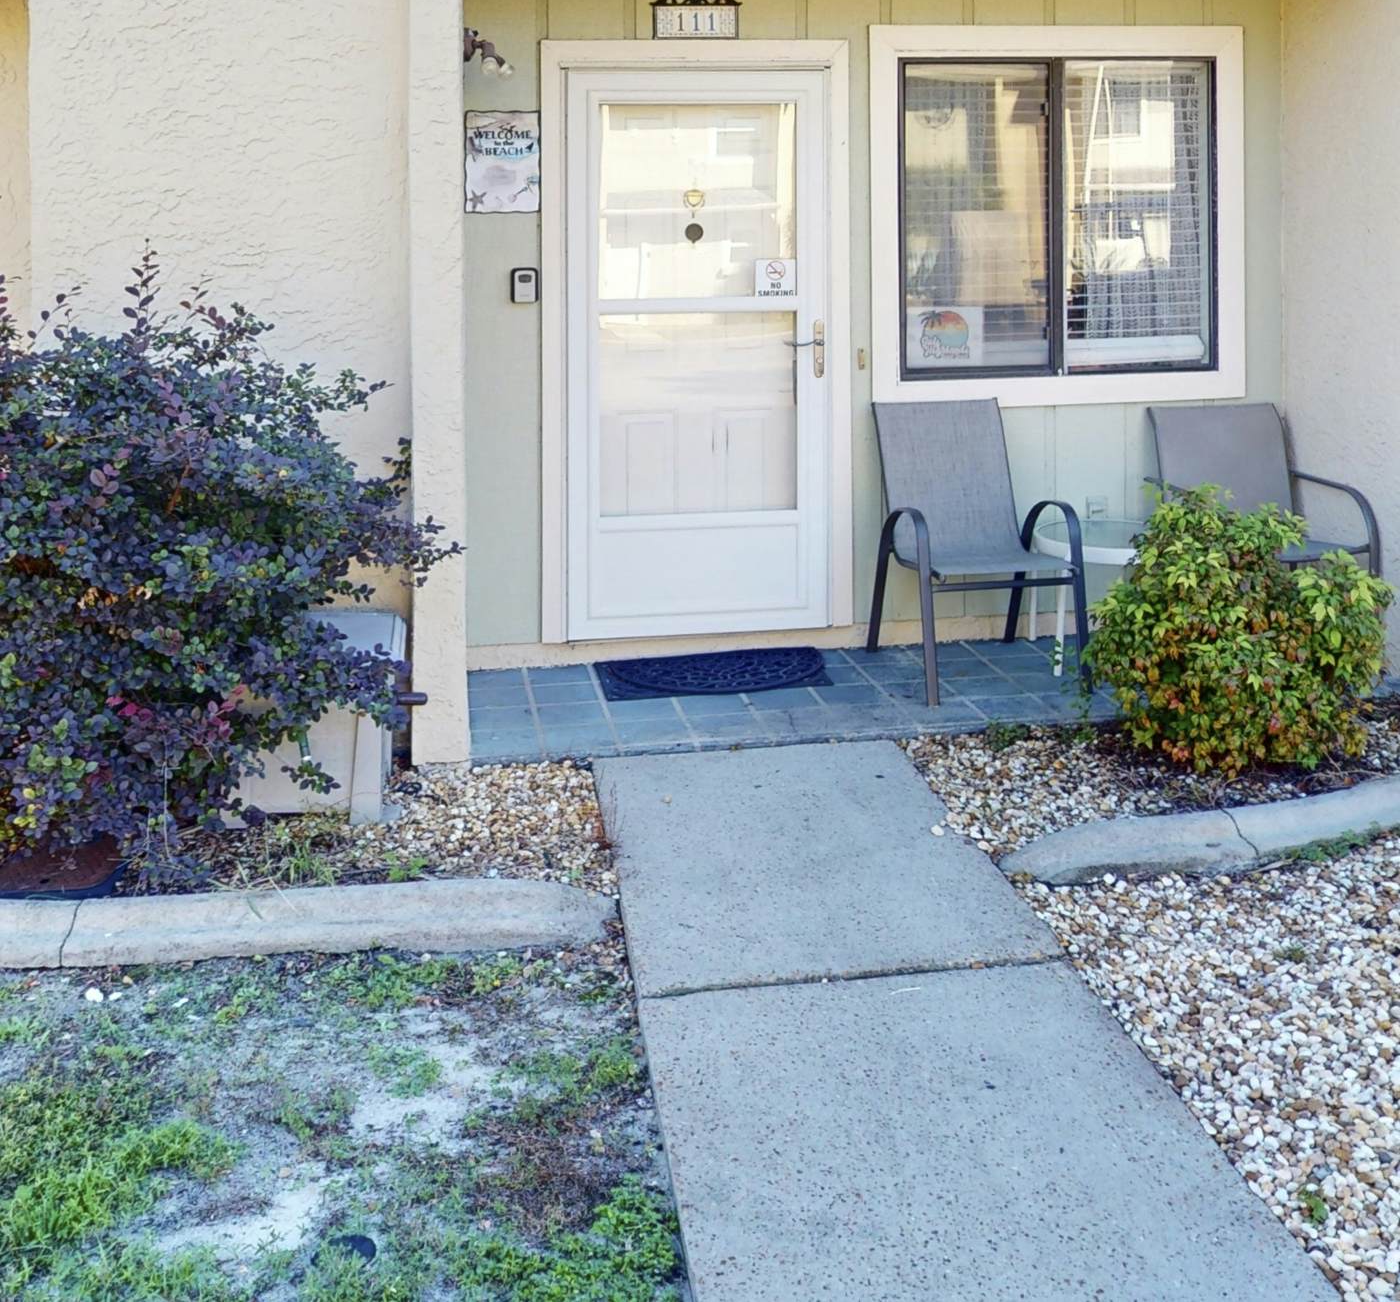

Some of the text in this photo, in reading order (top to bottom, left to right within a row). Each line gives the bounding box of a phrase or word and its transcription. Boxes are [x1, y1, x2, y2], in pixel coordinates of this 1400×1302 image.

[677, 11, 715, 31] 111
[474, 130, 532, 140] WELCOME
[485, 147, 523, 156] BEACH
